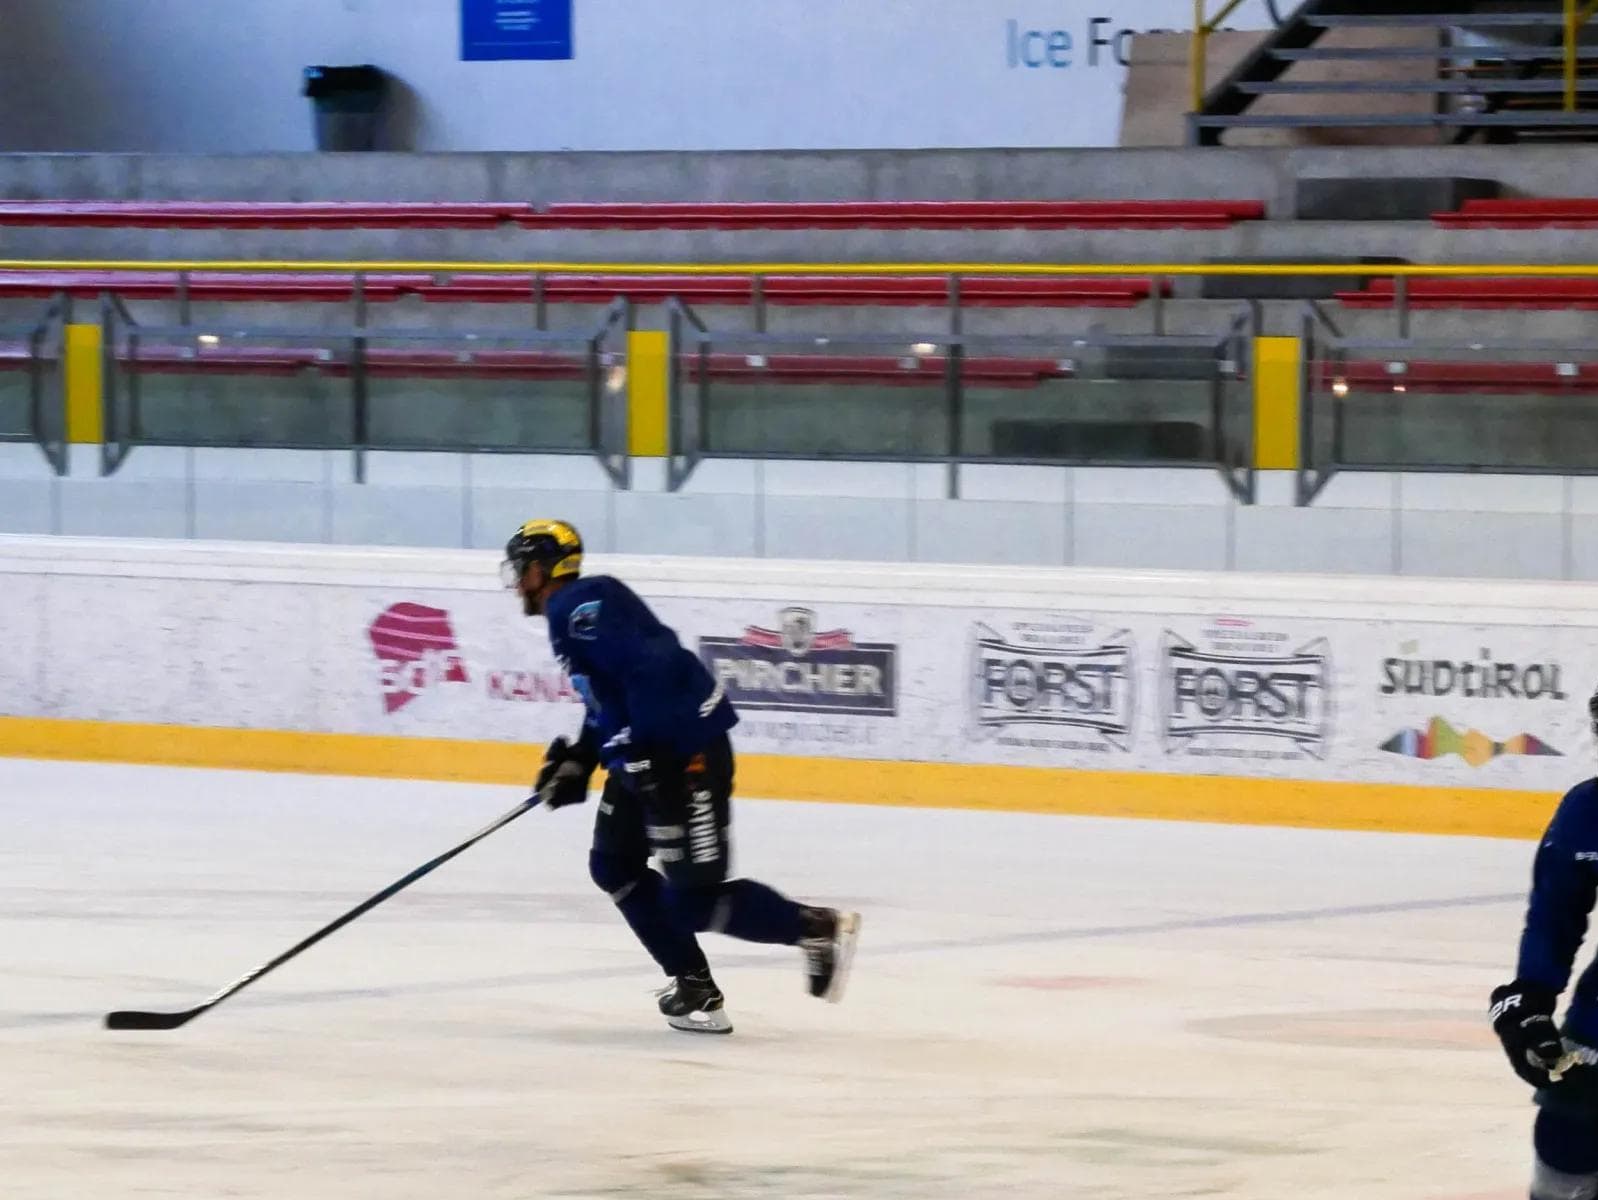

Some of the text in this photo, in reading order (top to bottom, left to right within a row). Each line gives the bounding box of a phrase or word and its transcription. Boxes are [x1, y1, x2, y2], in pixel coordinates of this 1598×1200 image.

[1006, 18, 1072, 68] Ice
[712, 658, 885, 697] PIRCHER
[984, 658, 1121, 714] FORST
[1173, 667, 1317, 722] FORST
